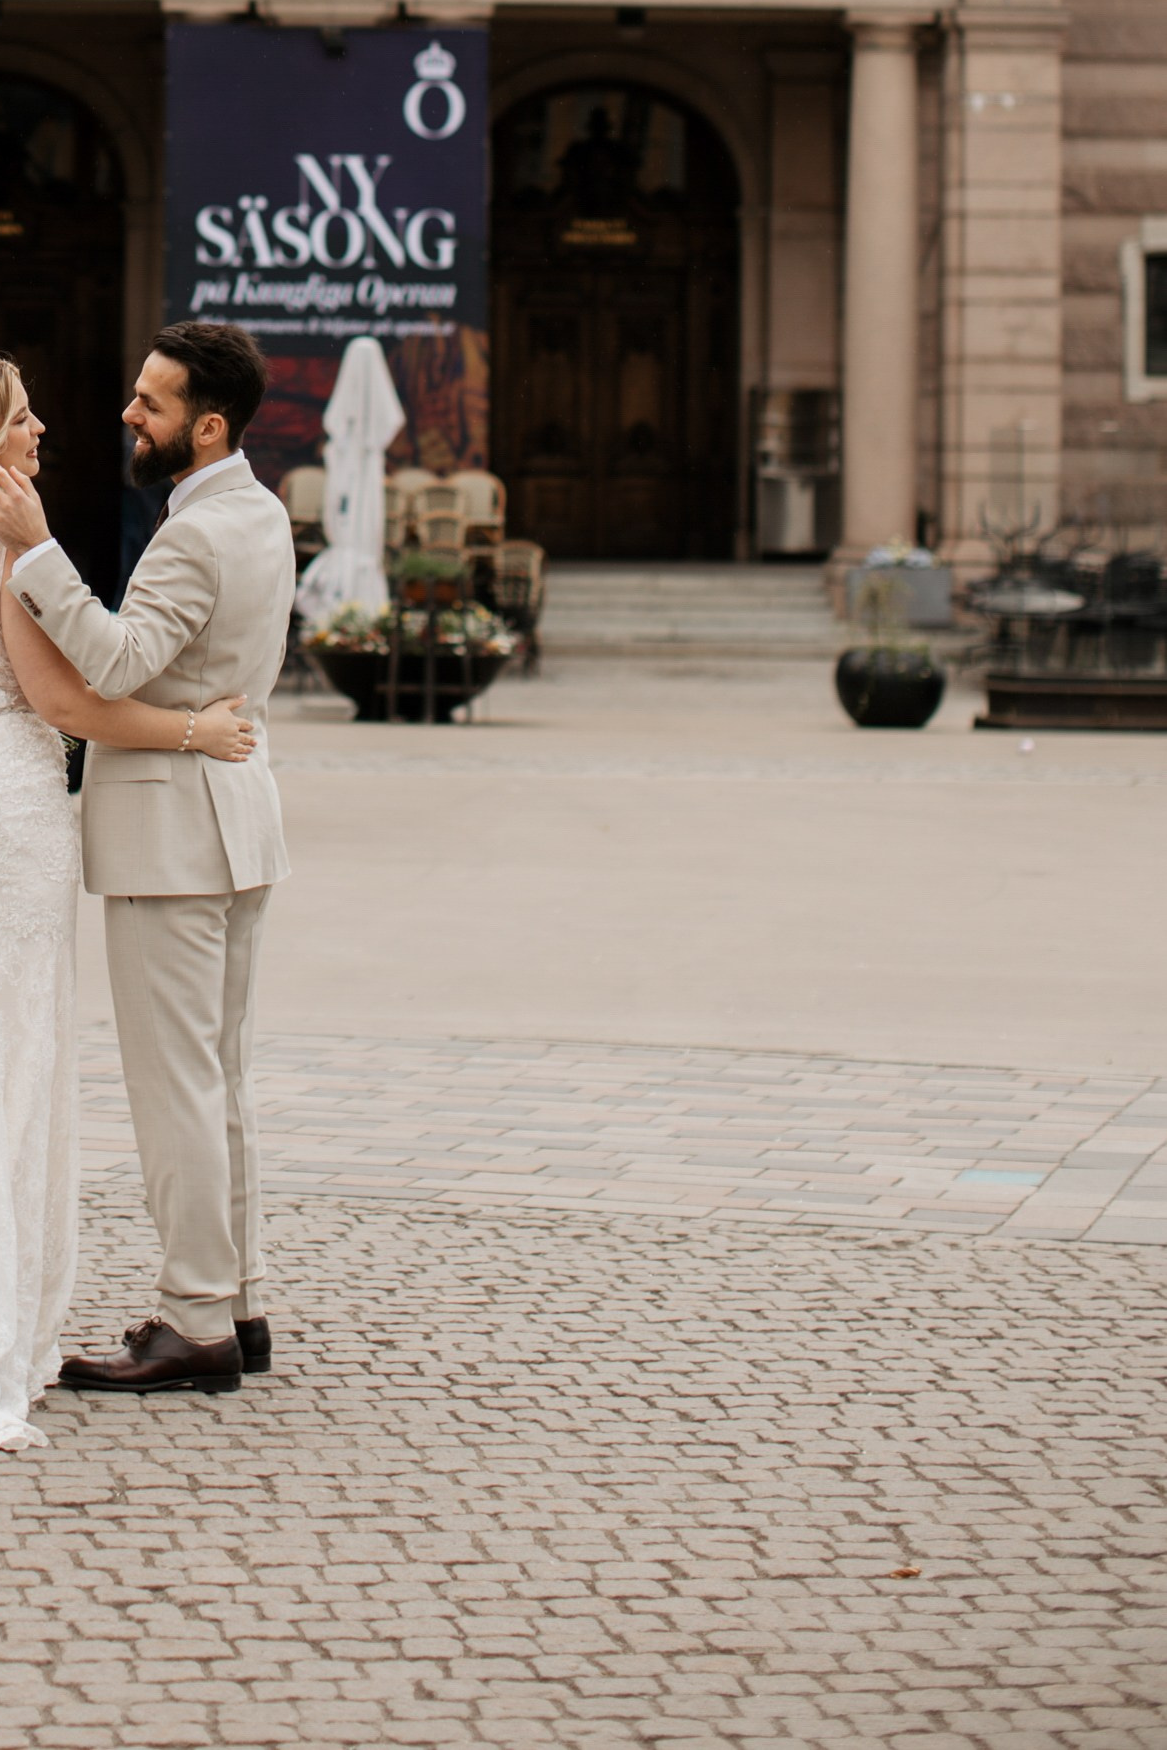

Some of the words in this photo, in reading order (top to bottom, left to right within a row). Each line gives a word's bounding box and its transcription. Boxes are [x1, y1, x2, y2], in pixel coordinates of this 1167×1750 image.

[295, 153, 390, 215] NY
[195, 196, 456, 269] SÄSONG
[233, 273, 354, 313] Kungliga
[356, 273, 456, 314] Operan
